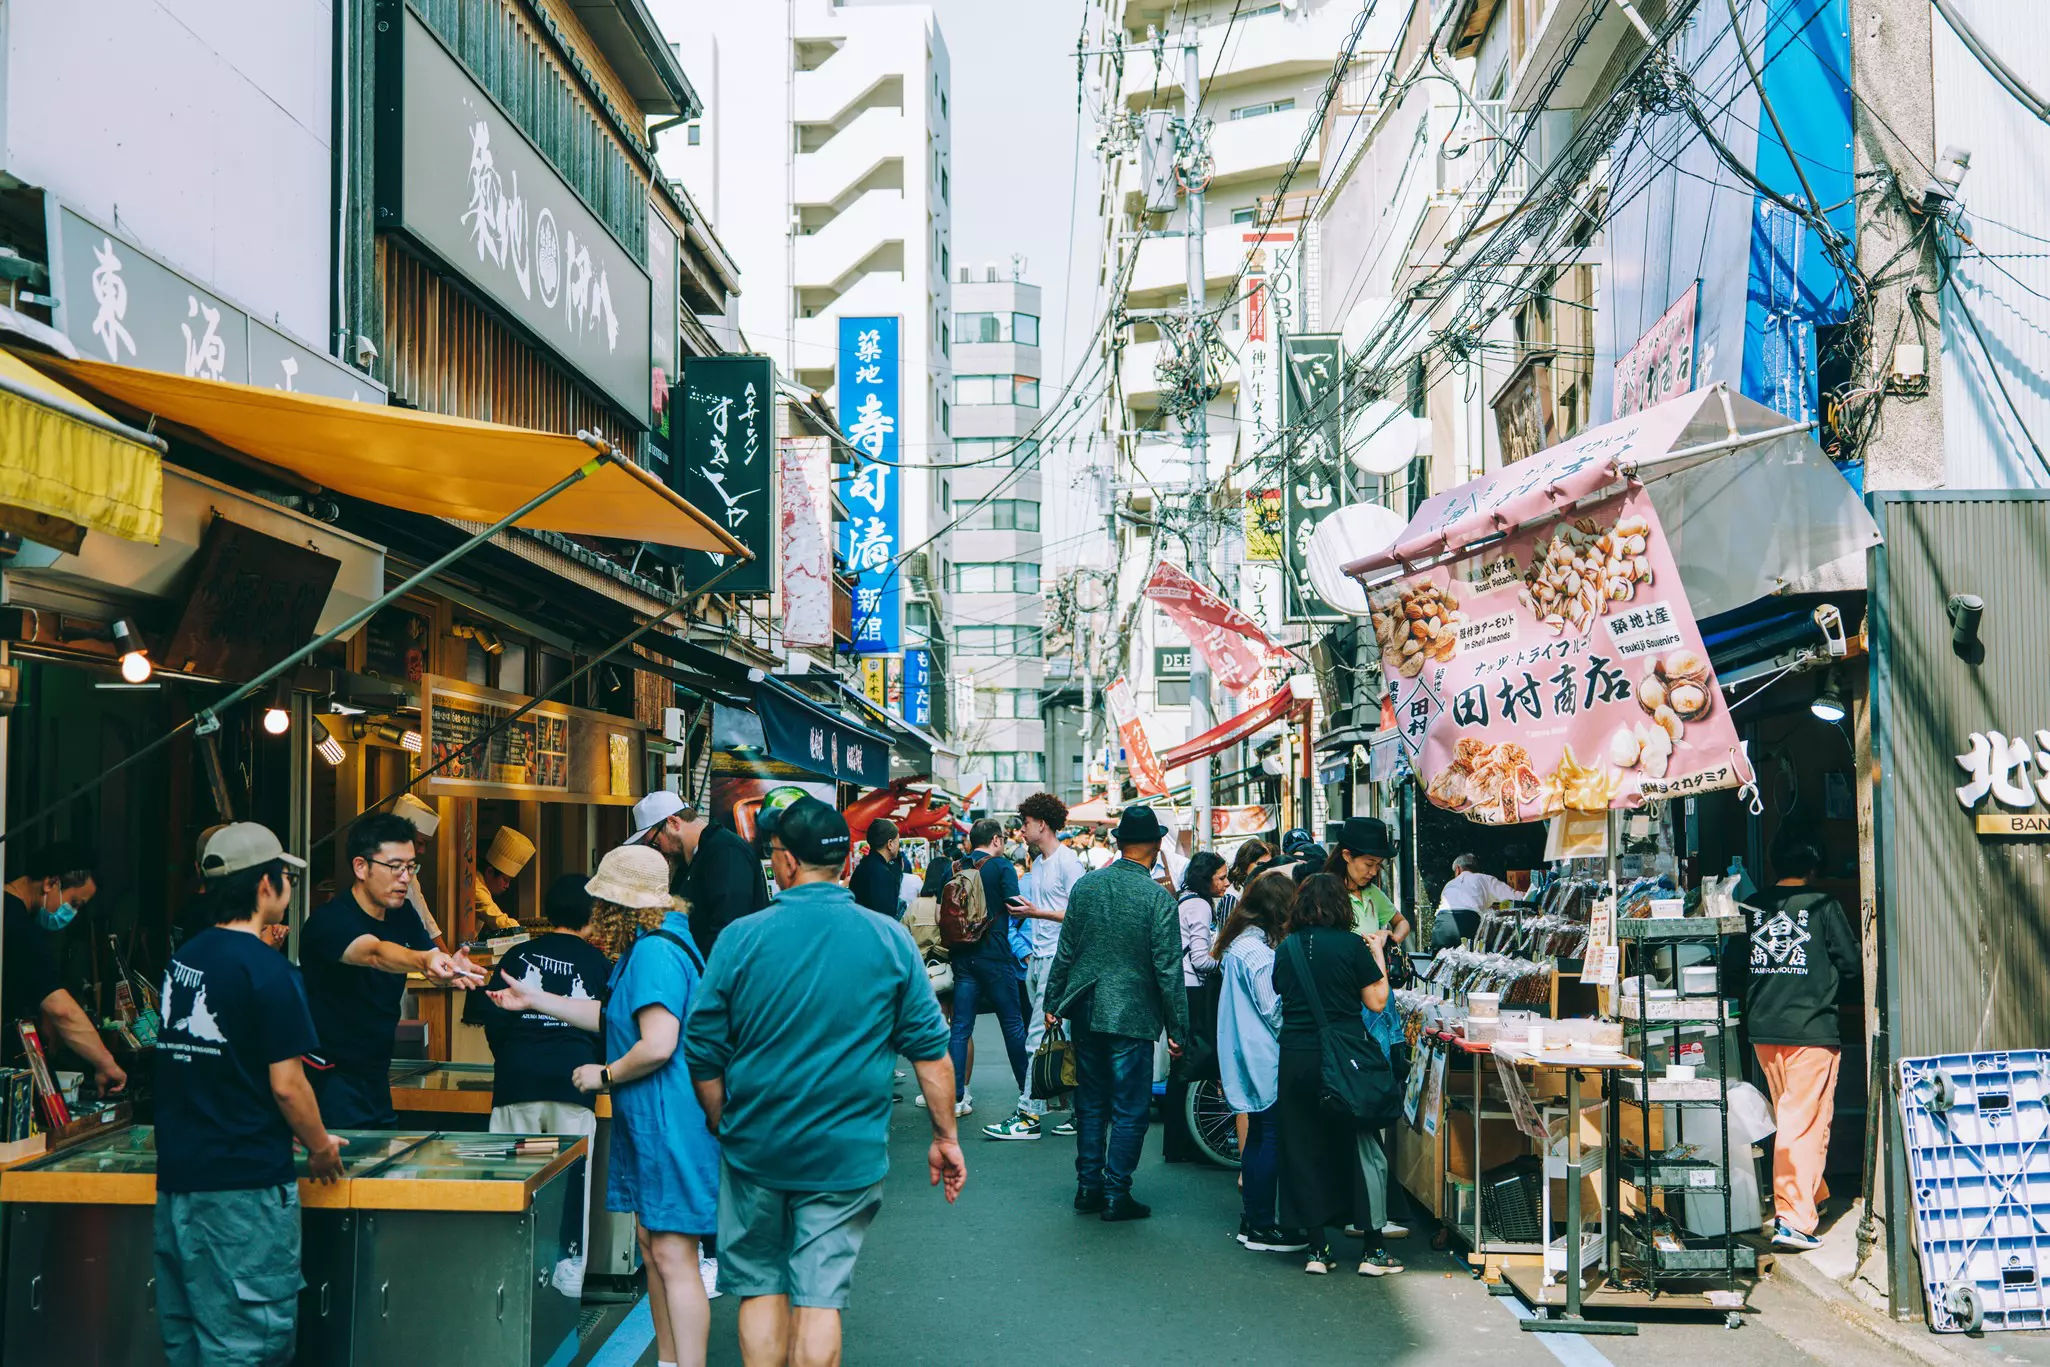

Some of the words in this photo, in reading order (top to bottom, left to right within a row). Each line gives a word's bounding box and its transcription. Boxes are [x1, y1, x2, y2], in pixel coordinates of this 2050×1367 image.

[854, 328, 884, 385] 築地
[846, 393, 895, 575] 寿司清
[1475, 582, 1491, 594] Roast
[1492, 572, 1518, 588] Pistachio
[853, 587, 883, 642] 新館
[1610, 606, 1671, 635] 築地土産
[1464, 642, 1471, 650] In
[1471, 637, 1486, 649] Shell
[1486, 631, 1511, 645] Almonds
[1618, 639, 1646, 655] Tsukiji
[1646, 634, 1681, 649] Souvenirs
[916, 651, 929, 724] もりた屋
[1389, 680, 1399, 705] 東京
[1453, 655, 1631, 727] 田村商店
[1407, 697, 1430, 737] 田村
[1768, 920, 1793, 953] 田村
